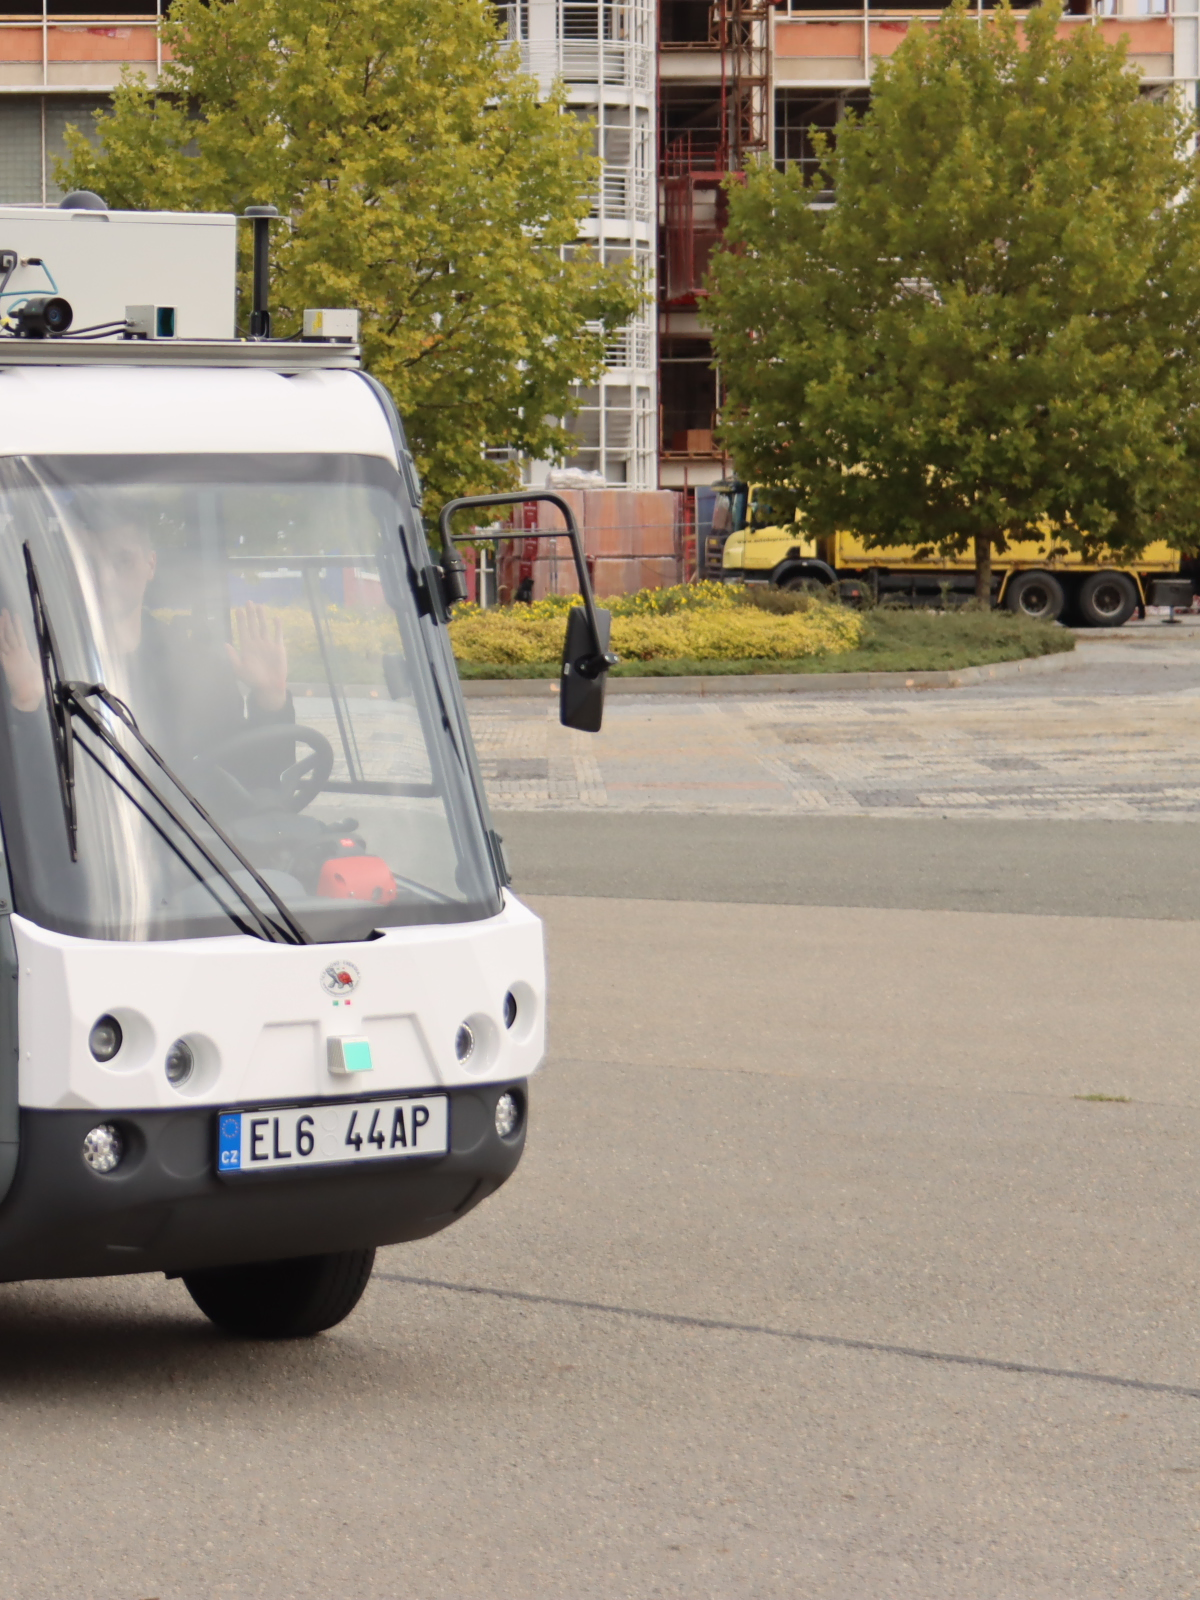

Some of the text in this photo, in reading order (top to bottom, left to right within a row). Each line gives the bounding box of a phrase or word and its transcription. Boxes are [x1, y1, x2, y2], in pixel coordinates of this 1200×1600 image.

[250, 1104, 430, 1162] EL6 44AP
[221, 1150, 238, 1164] CZ
